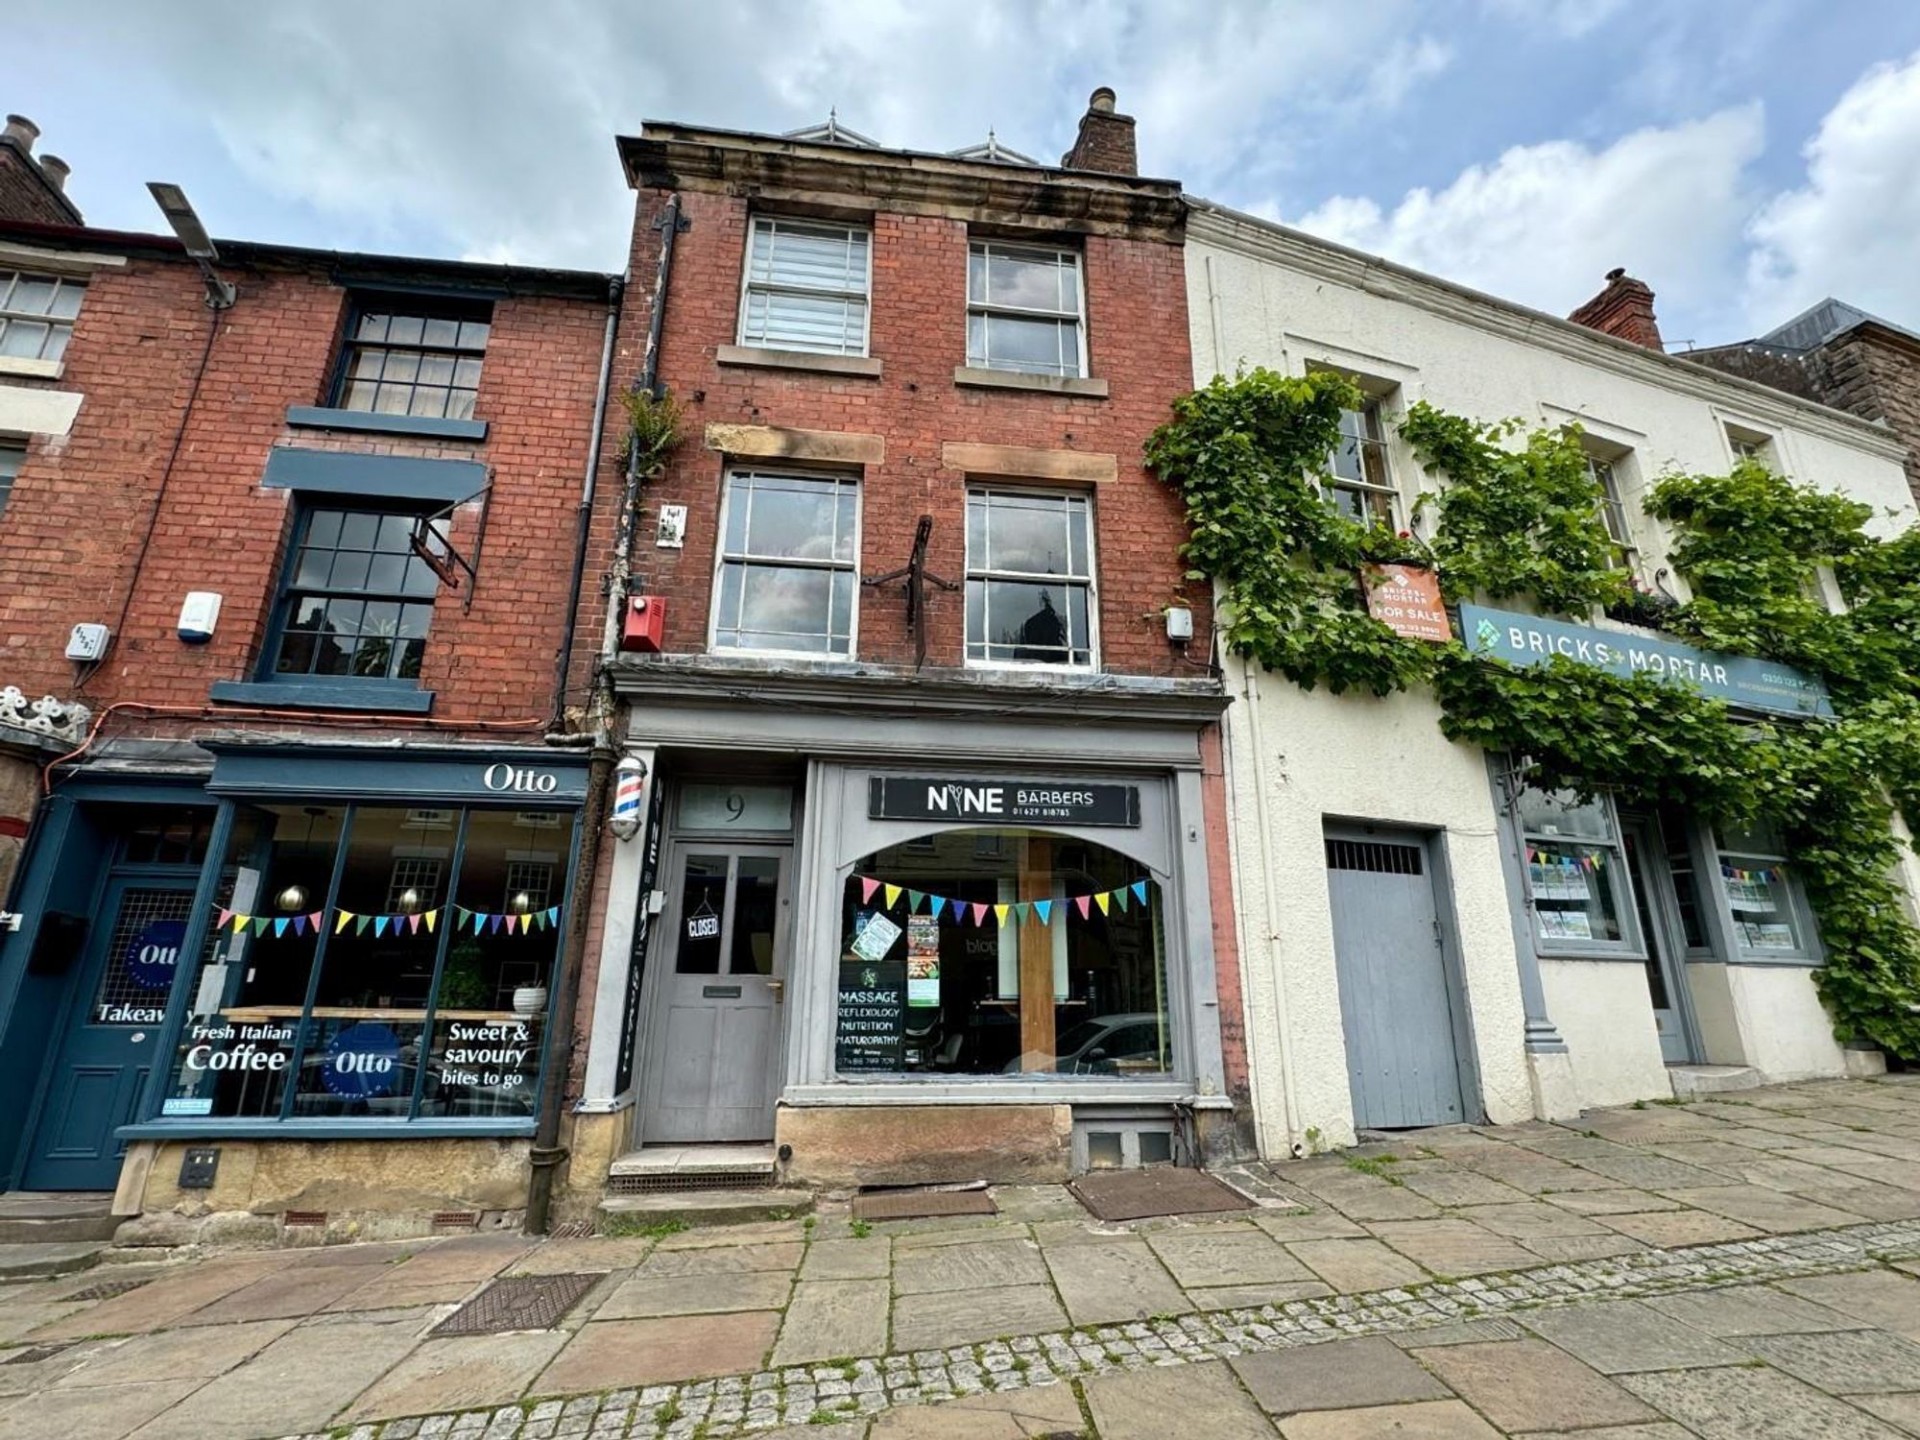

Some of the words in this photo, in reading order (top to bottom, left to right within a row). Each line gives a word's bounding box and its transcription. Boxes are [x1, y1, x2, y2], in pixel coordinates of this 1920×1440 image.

[1406, 608, 1441, 623] SALE
[1508, 627, 1610, 664] BRICKS
[1628, 648, 1729, 686] MORTAR
[484, 763, 557, 792] Otto
[1017, 789, 1094, 805] BARBERS
[726, 793, 745, 823] 9
[688, 917, 718, 938] CLOSED
[140, 944, 180, 965] Ott
[839, 991, 899, 1004] MASSAGE
[99, 1003, 196, 1029] Takeay
[838, 1007, 900, 1018] REFLEXOLOGY
[191, 1024, 235, 1040] Fresh
[240, 1024, 292, 1040] Italian
[450, 1022, 507, 1042] Sweet
[513, 1023, 529, 1042] &
[841, 1021, 894, 1031] NUTRITION
[836, 1035, 900, 1046] NATUROPATHY
[187, 1043, 286, 1071] Coffee
[336, 1051, 392, 1074] Otto
[445, 1047, 527, 1068] savoury
[441, 1069, 478, 1086] bites
[484, 1070, 500, 1086] to
[502, 1073, 523, 1090] go
